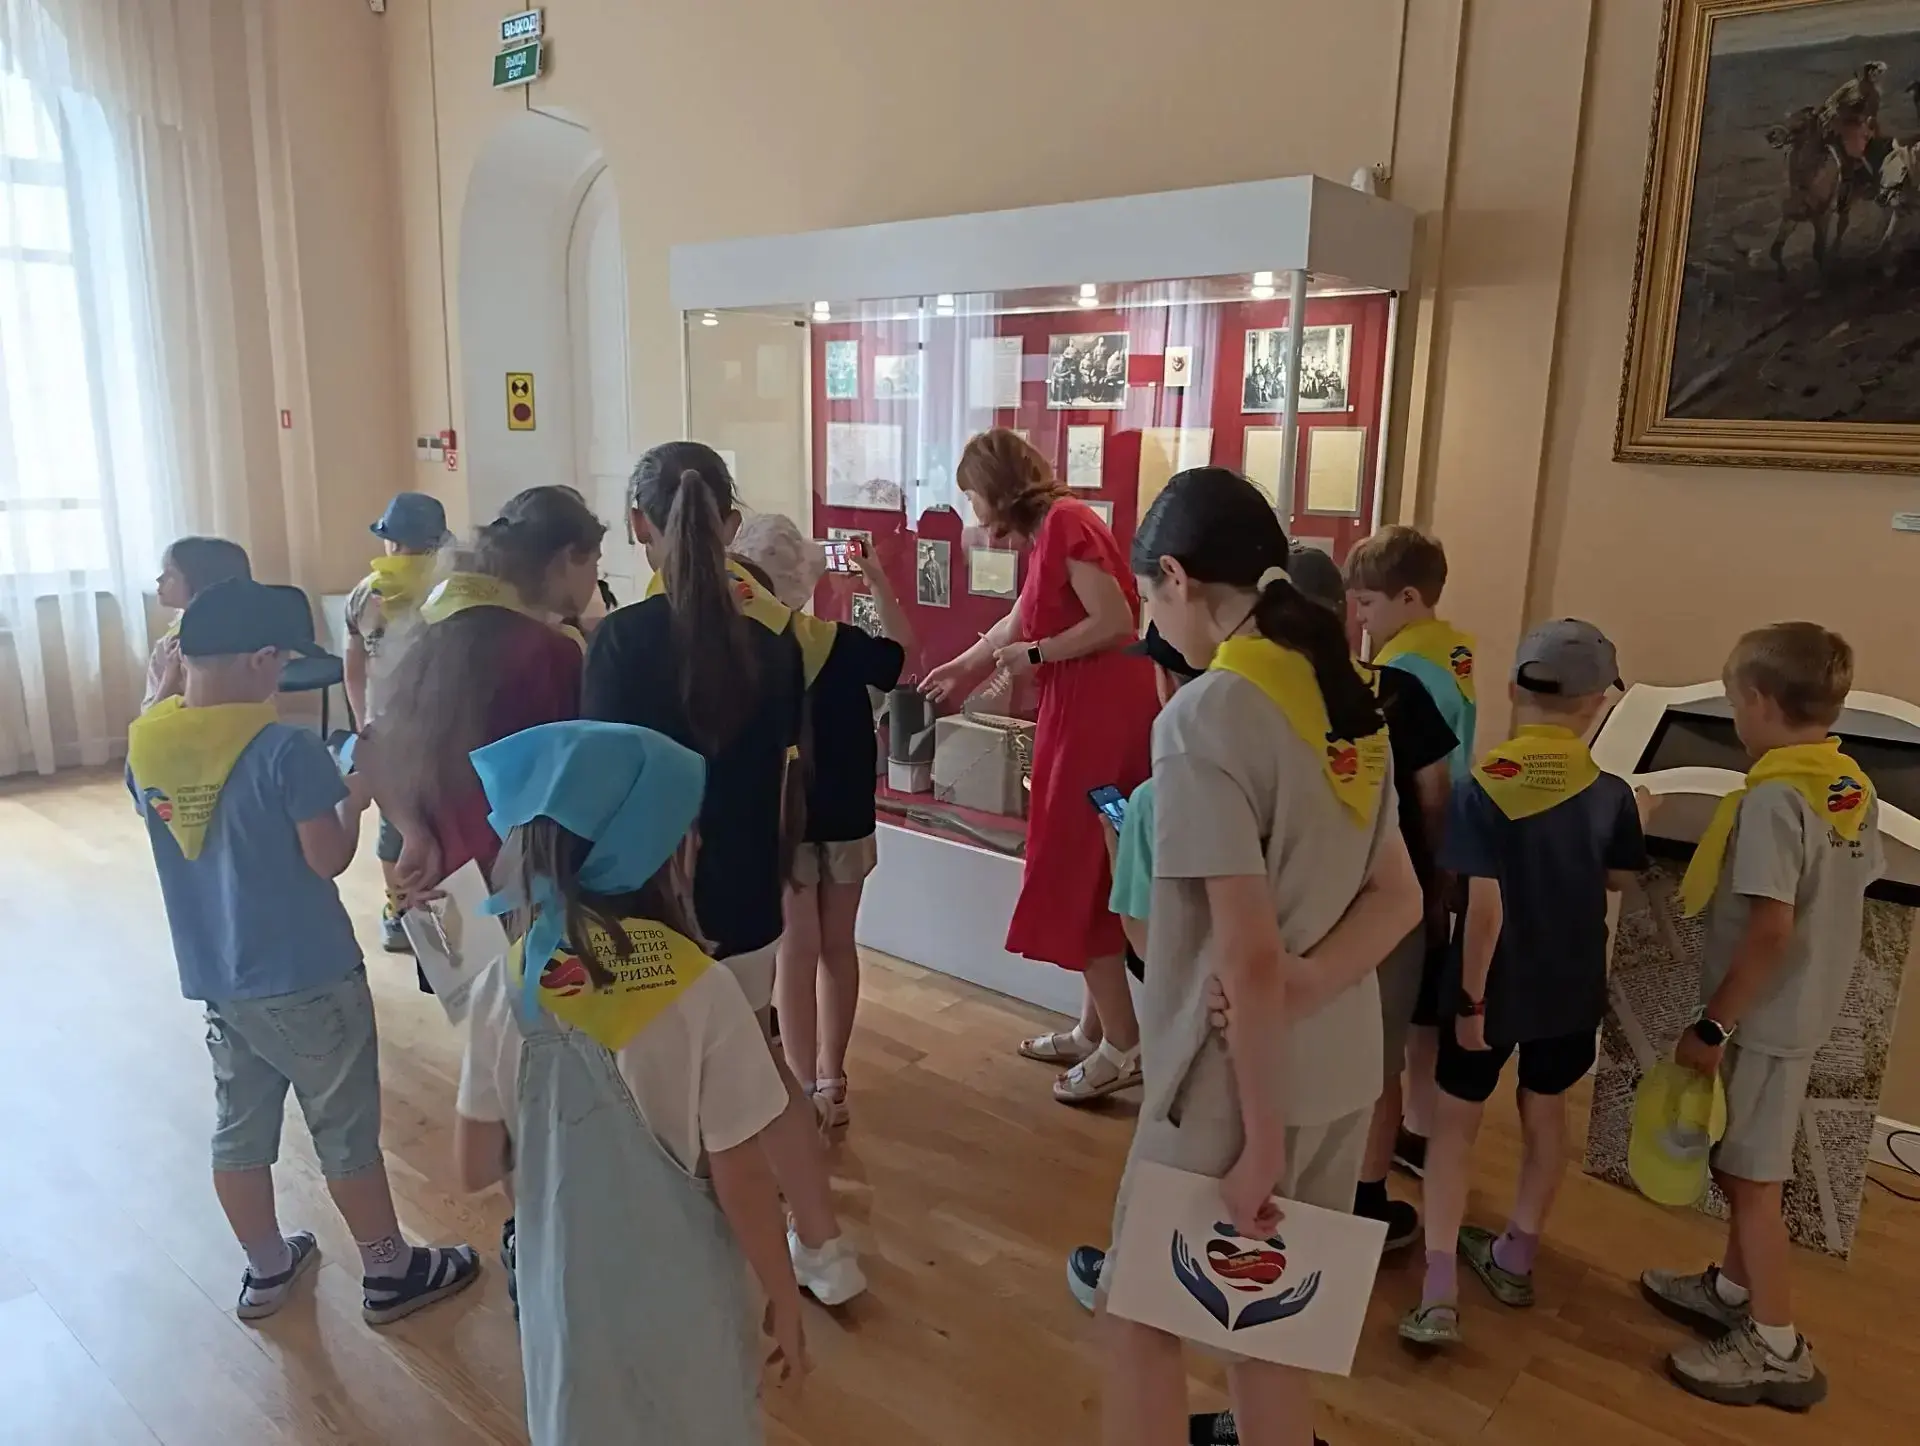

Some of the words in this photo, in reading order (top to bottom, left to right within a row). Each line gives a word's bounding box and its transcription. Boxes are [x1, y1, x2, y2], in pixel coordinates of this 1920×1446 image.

[504, 15, 536, 37] ВЫХОД
[593, 930, 664, 941] АГТСТВО
[614, 964, 675, 982] РИЗМА
